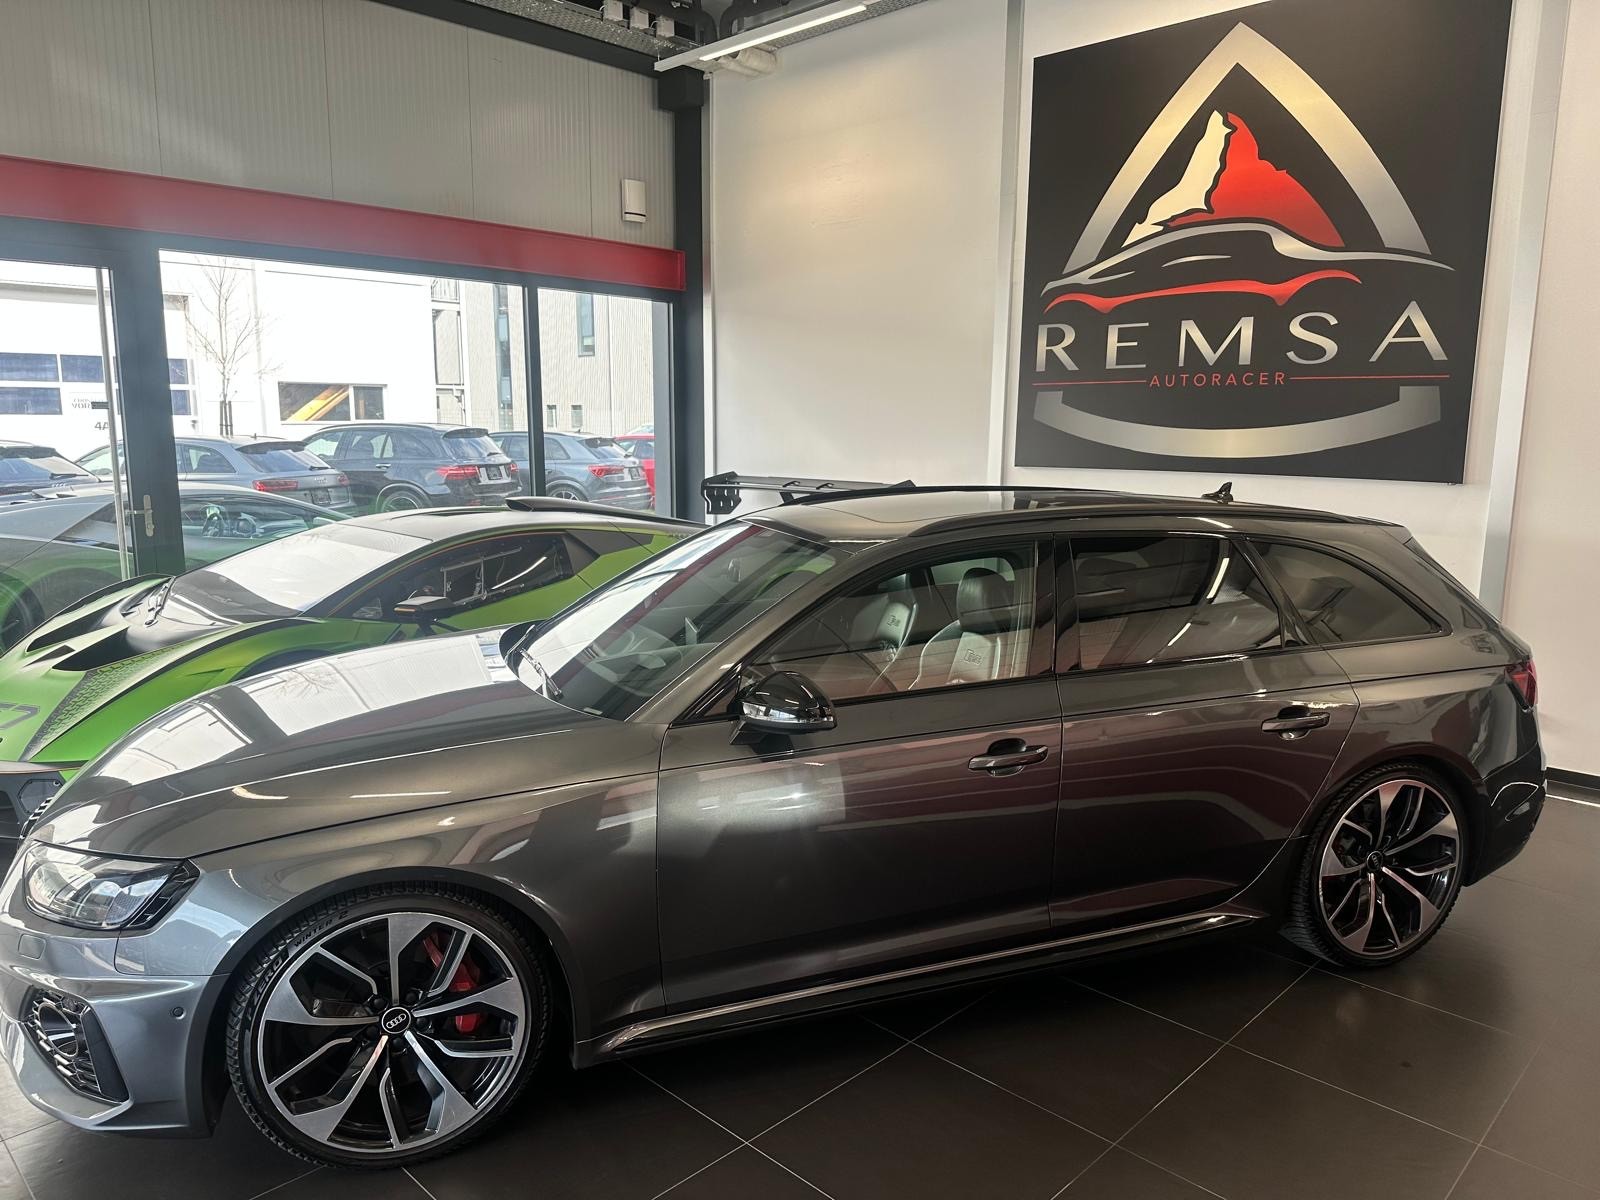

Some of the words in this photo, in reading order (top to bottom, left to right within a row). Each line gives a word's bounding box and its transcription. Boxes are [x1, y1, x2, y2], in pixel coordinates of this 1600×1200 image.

[1035, 300, 1448, 372] REMSA
[1149, 372, 1287, 388] AUTORACER
[294, 919, 334, 948] WINTER
